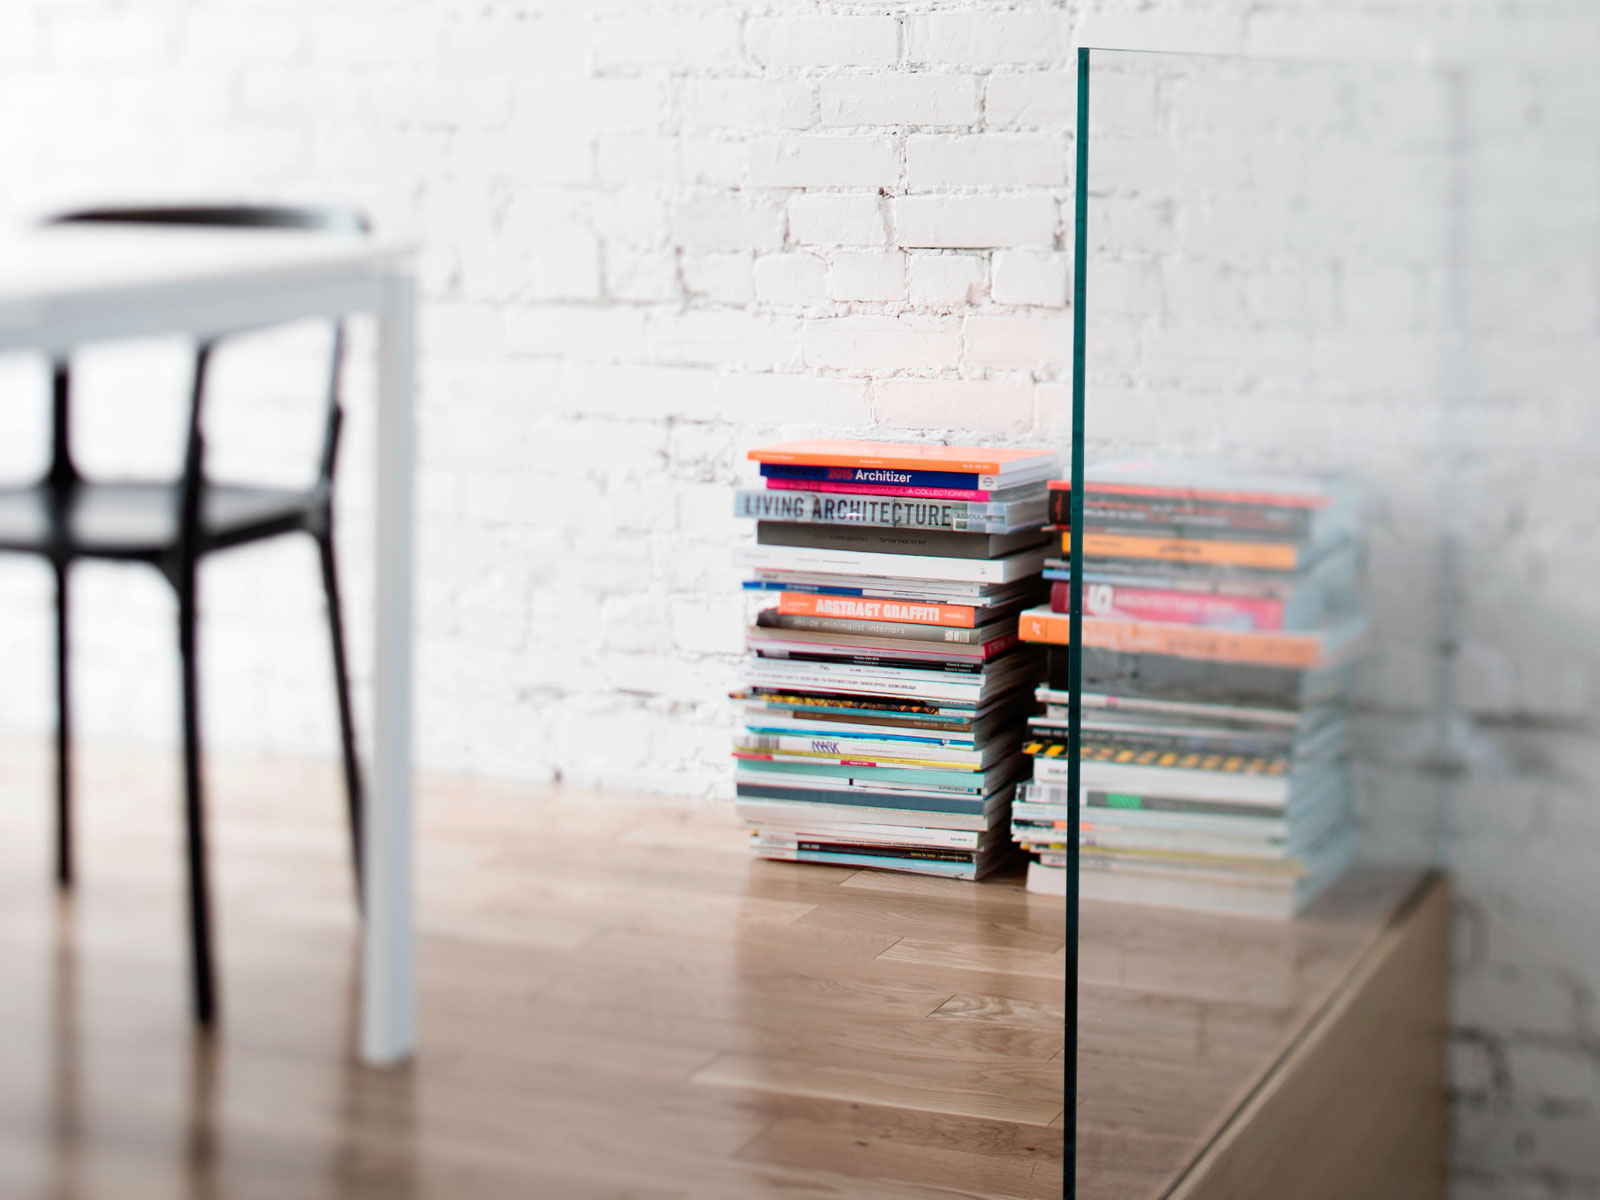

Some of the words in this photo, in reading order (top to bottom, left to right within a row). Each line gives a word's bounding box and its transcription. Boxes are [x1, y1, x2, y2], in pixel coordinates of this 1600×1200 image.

[827, 467, 854, 480] 2015
[855, 469, 912, 483] Architizer
[914, 489, 976, 498] COLLECTIONNER
[745, 495, 804, 517] LIVING
[812, 498, 952, 527] ARCHITECTURE
[815, 598, 881, 618] ABSTRACT
[883, 603, 939, 622] GRAFFITI
[822, 619, 864, 632] minimalist
[868, 623, 905, 635] interiors
[812, 740, 841, 754] MARK
